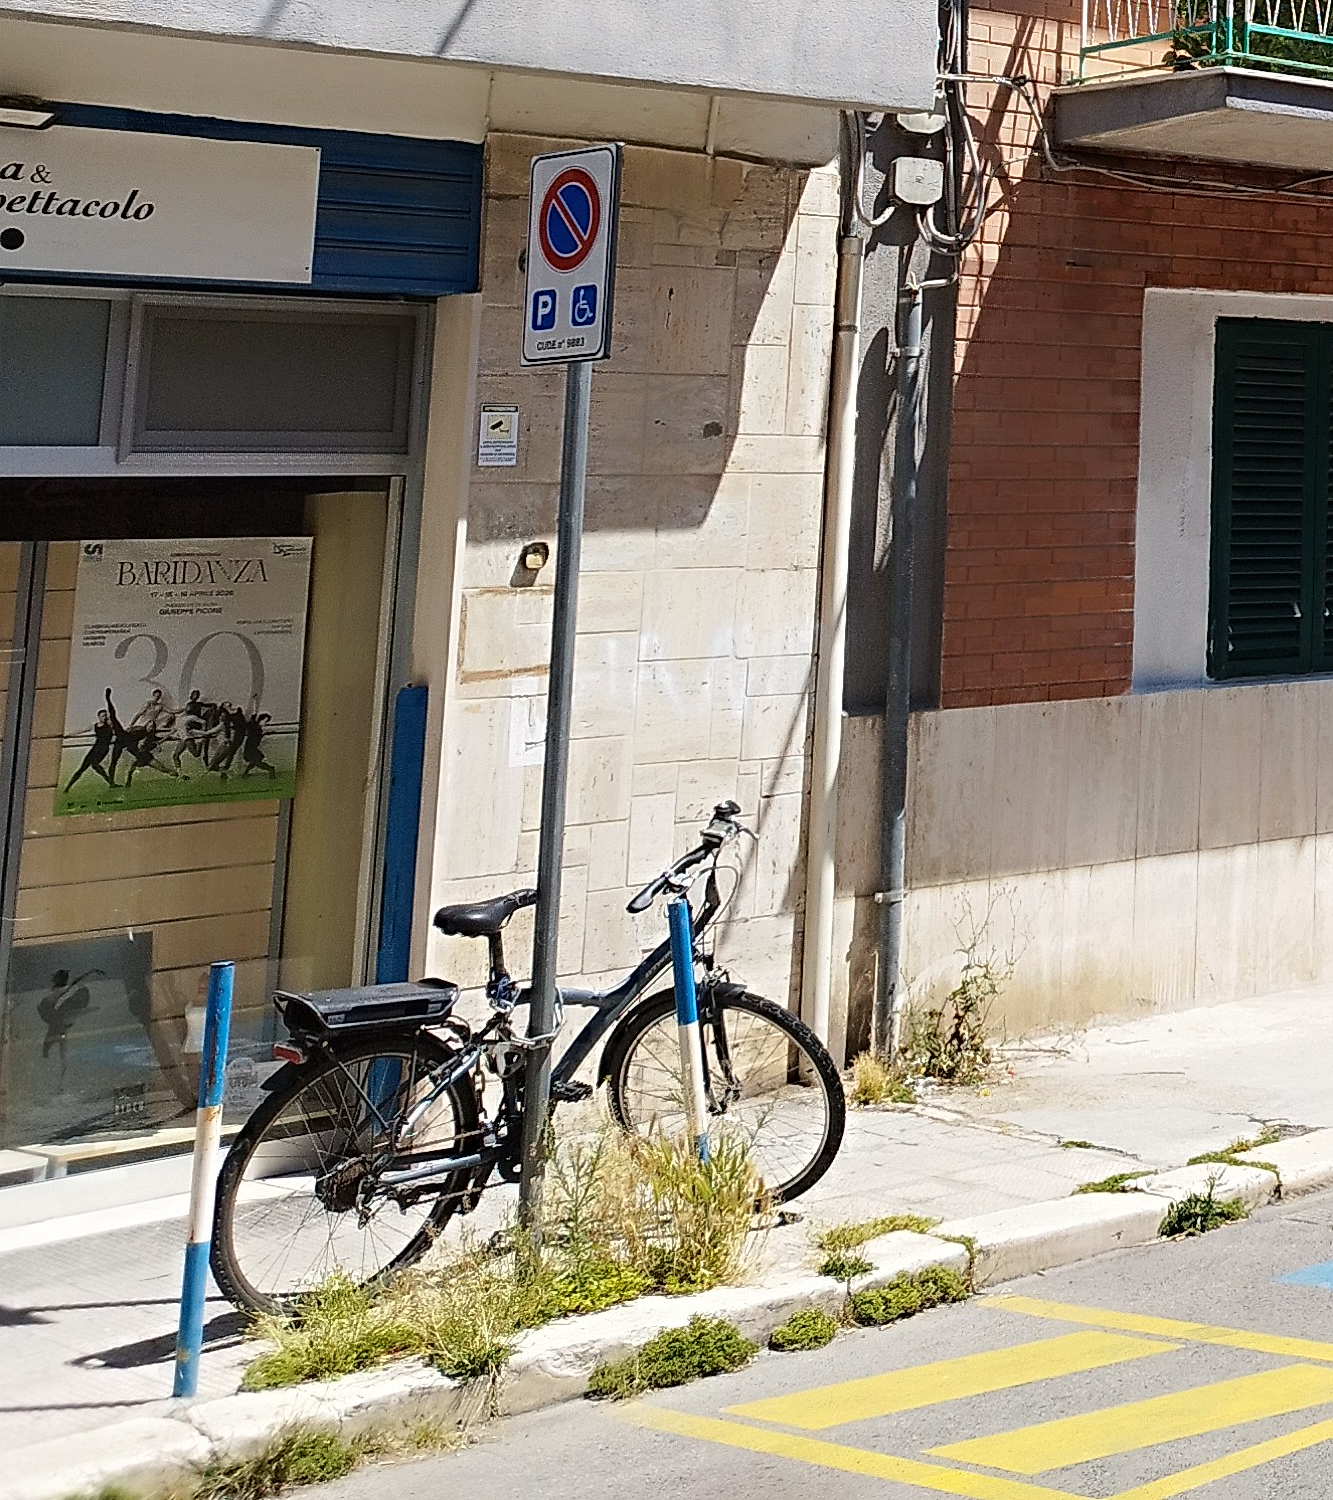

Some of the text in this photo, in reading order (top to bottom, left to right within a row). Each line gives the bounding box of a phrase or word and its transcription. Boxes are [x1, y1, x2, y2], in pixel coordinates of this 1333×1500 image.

[30, 164, 52, 184] &
[536, 294, 552, 326] P
[115, 559, 269, 586] BARIDANZA
